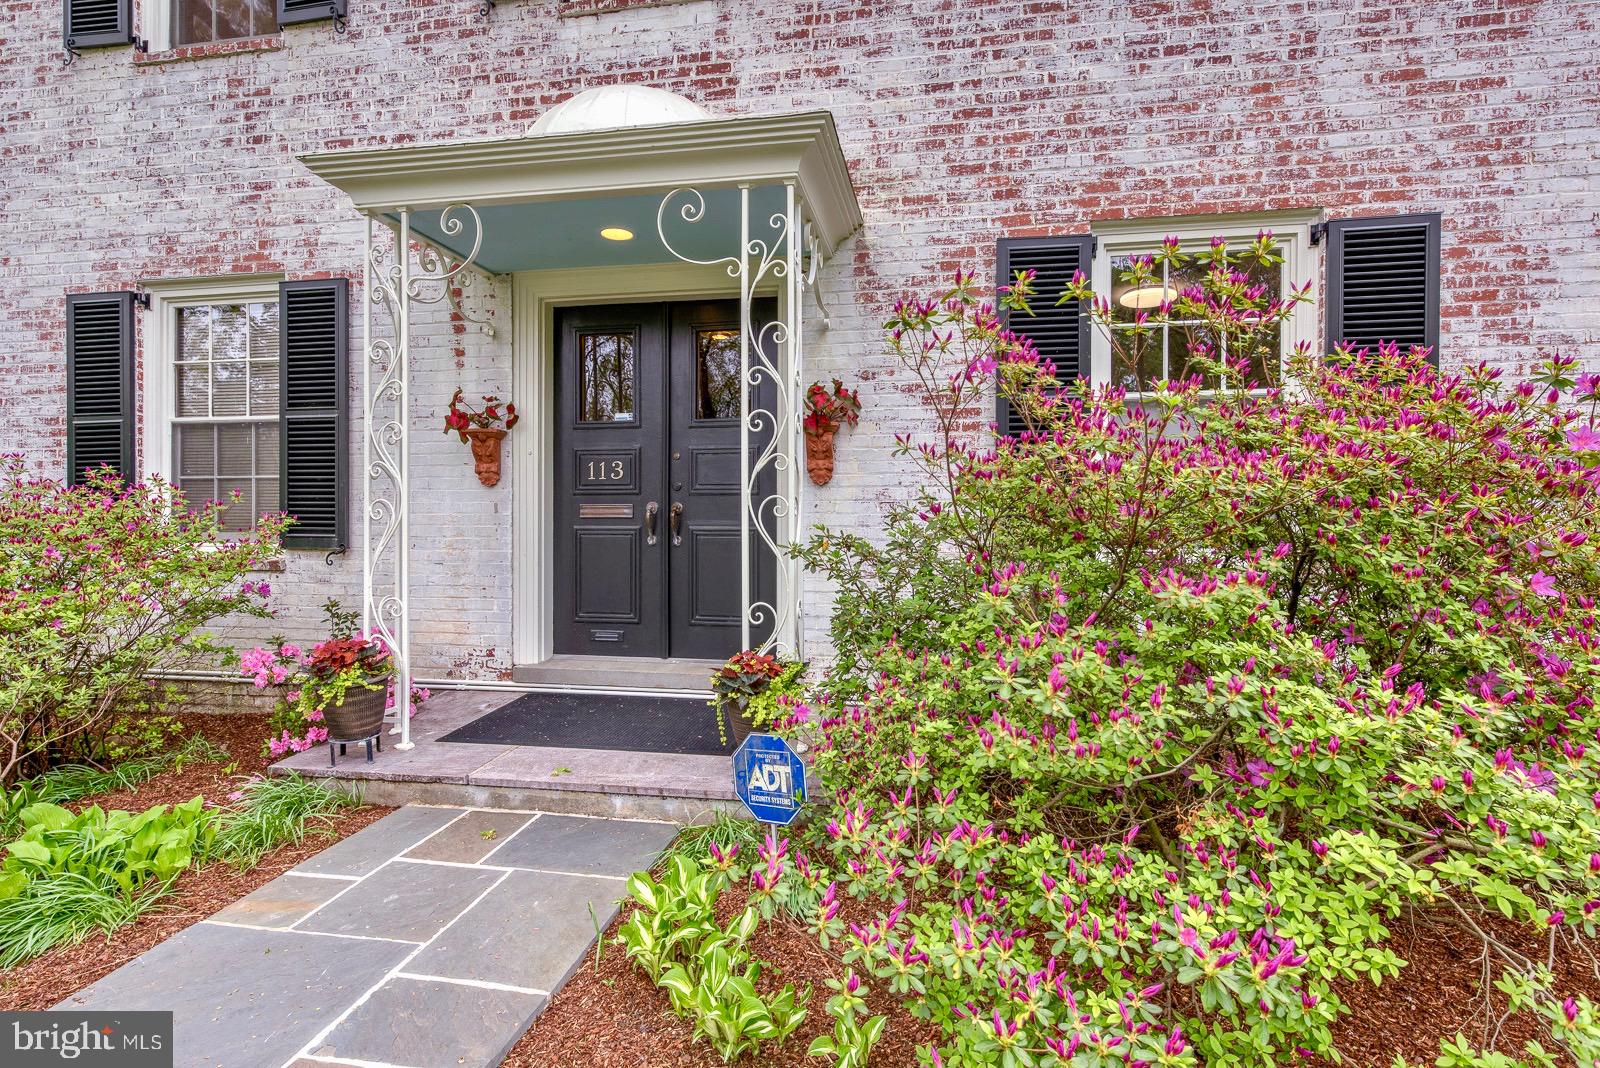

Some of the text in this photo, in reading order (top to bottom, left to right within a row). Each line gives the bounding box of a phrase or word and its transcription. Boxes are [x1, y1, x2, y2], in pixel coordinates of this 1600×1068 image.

[587, 460, 624, 480] 113
[747, 763, 791, 793] ADT
[750, 794, 792, 806] SECURITY SYSTEMS
